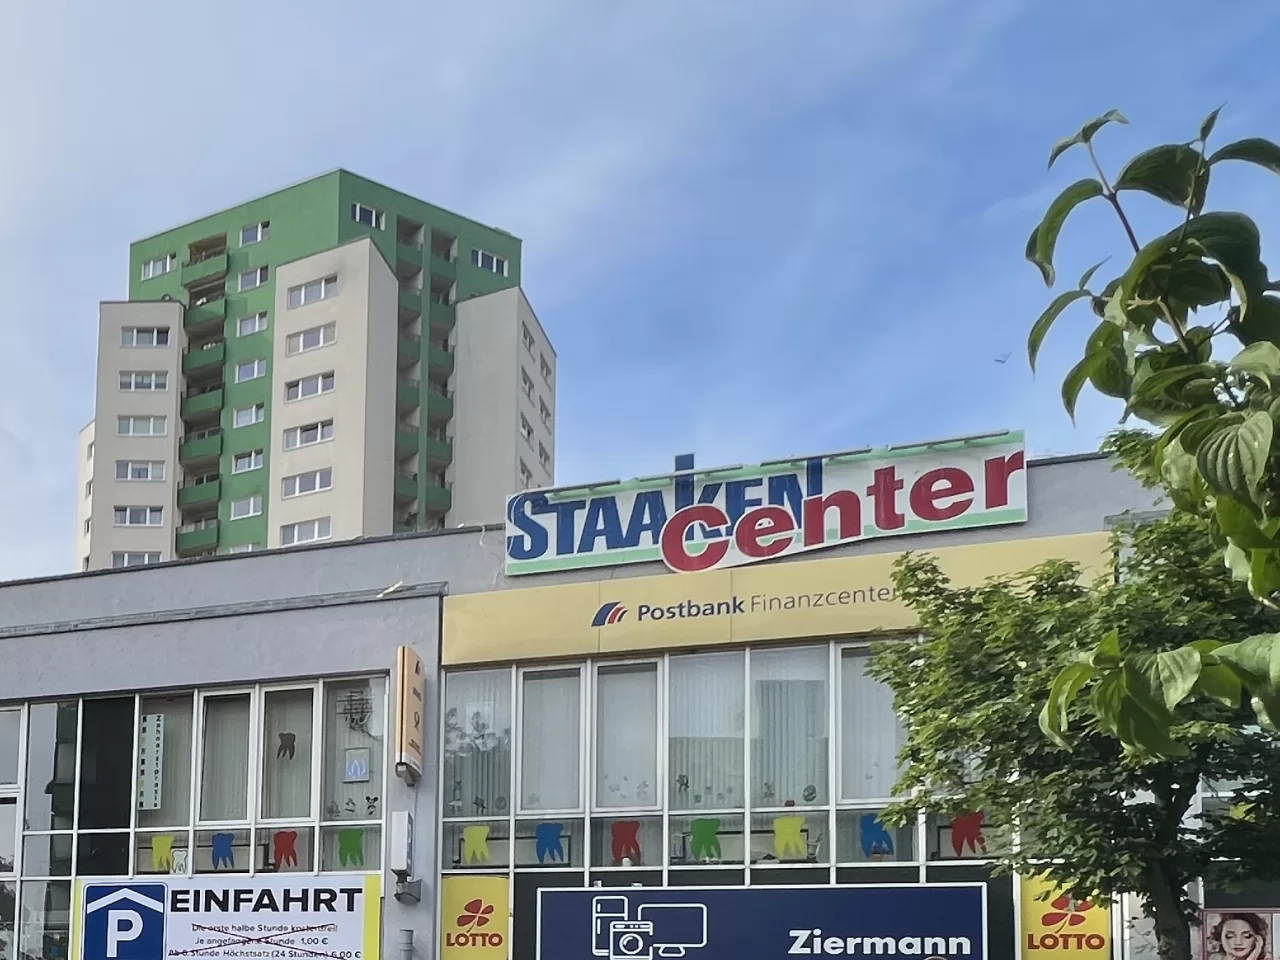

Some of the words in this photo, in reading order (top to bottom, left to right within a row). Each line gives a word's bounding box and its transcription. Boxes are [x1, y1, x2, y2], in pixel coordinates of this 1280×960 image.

[507, 453, 823, 561] STAAKEN
[660, 449, 1025, 573] center
[637, 596, 745, 622] Postbank
[170, 887, 363, 913] EINFAHRT
[106, 909, 144, 958] P
[231, 924, 255, 932] halbe
[257, 924, 289, 932] Stunde
[445, 932, 503, 948] LOTTO
[191, 949, 220, 957] Stunde
[223, 949, 270, 958] Höchstsatz
[271, 950, 286, 959] (24
[354, 950, 362, 959] €
[195, 937, 205, 945] Je
[300, 937, 319, 946] 1,00
[321, 937, 329, 945] €
[787, 928, 972, 955] Ziermann
[1027, 933, 1106, 950] LOTTO
